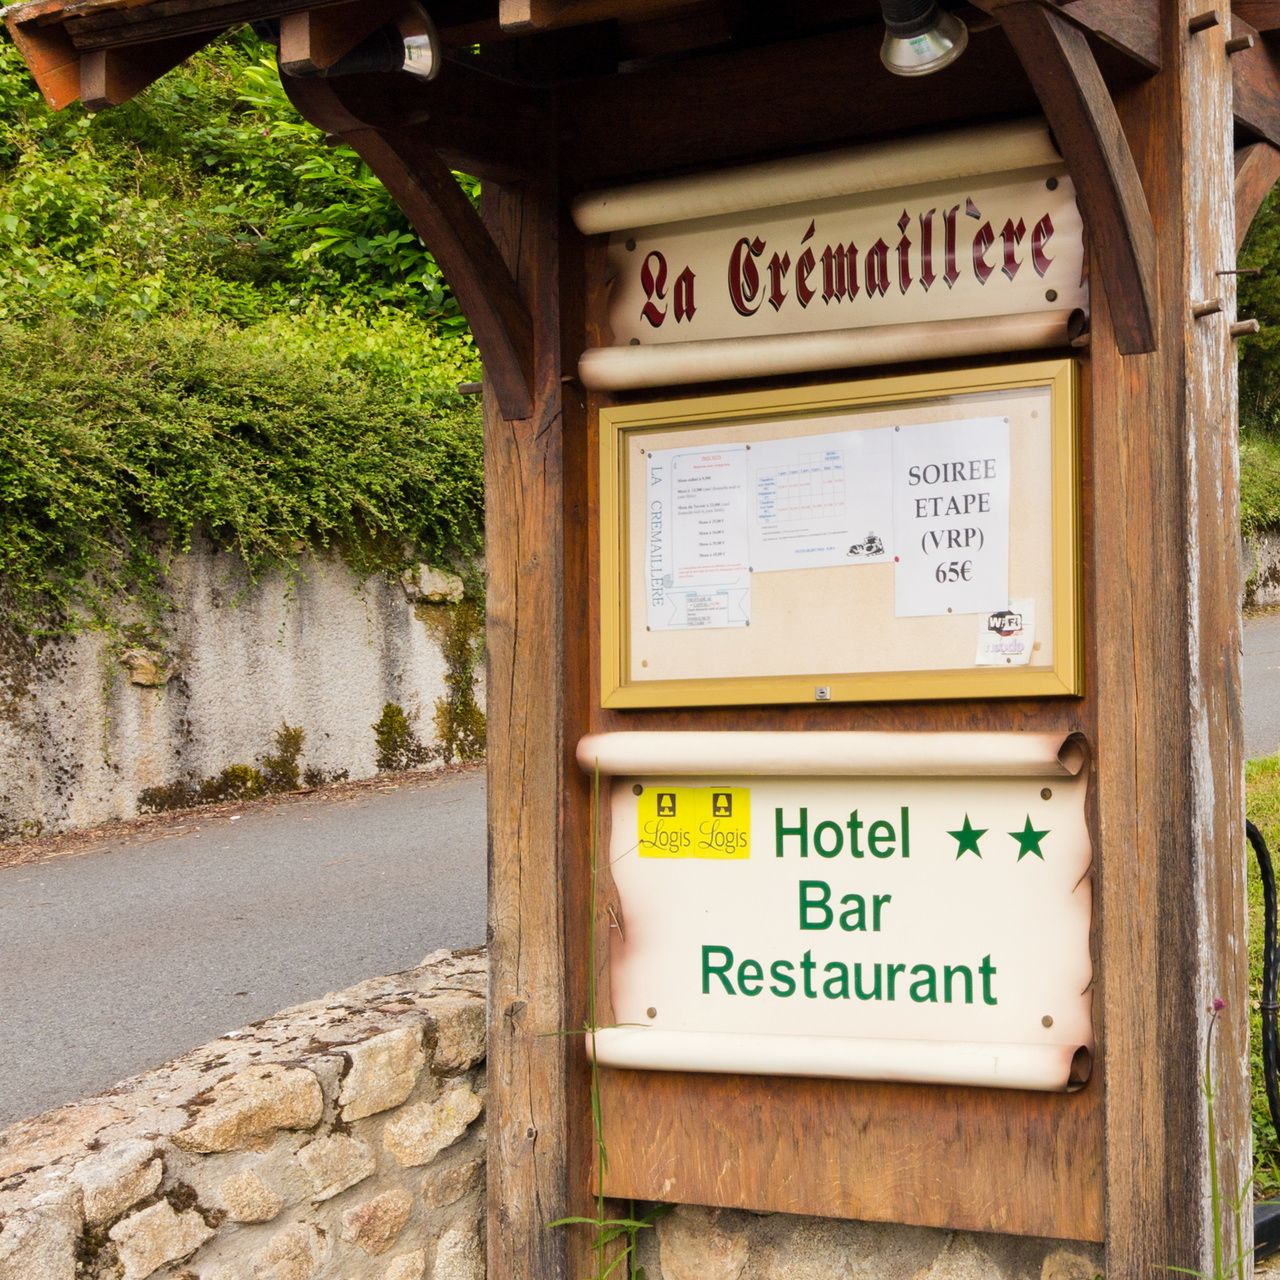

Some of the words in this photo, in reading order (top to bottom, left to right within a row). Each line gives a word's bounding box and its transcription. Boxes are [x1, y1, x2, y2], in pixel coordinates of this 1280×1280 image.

[639, 249, 697, 329] La
[727, 196, 1057, 318] Crémaillère
[650, 466, 663, 487] LA
[908, 458, 997, 486] SOIREE
[914, 492, 991, 518] ETAPE
[921, 527, 985, 555] (VRP)
[935, 559, 974, 583] 65€
[640, 818, 691, 853] Logis
[697, 818, 748, 854] Logis
[775, 806, 910, 859] Hotel
[798, 879, 892, 932] Bar
[701, 944, 998, 1005] Restaurant
